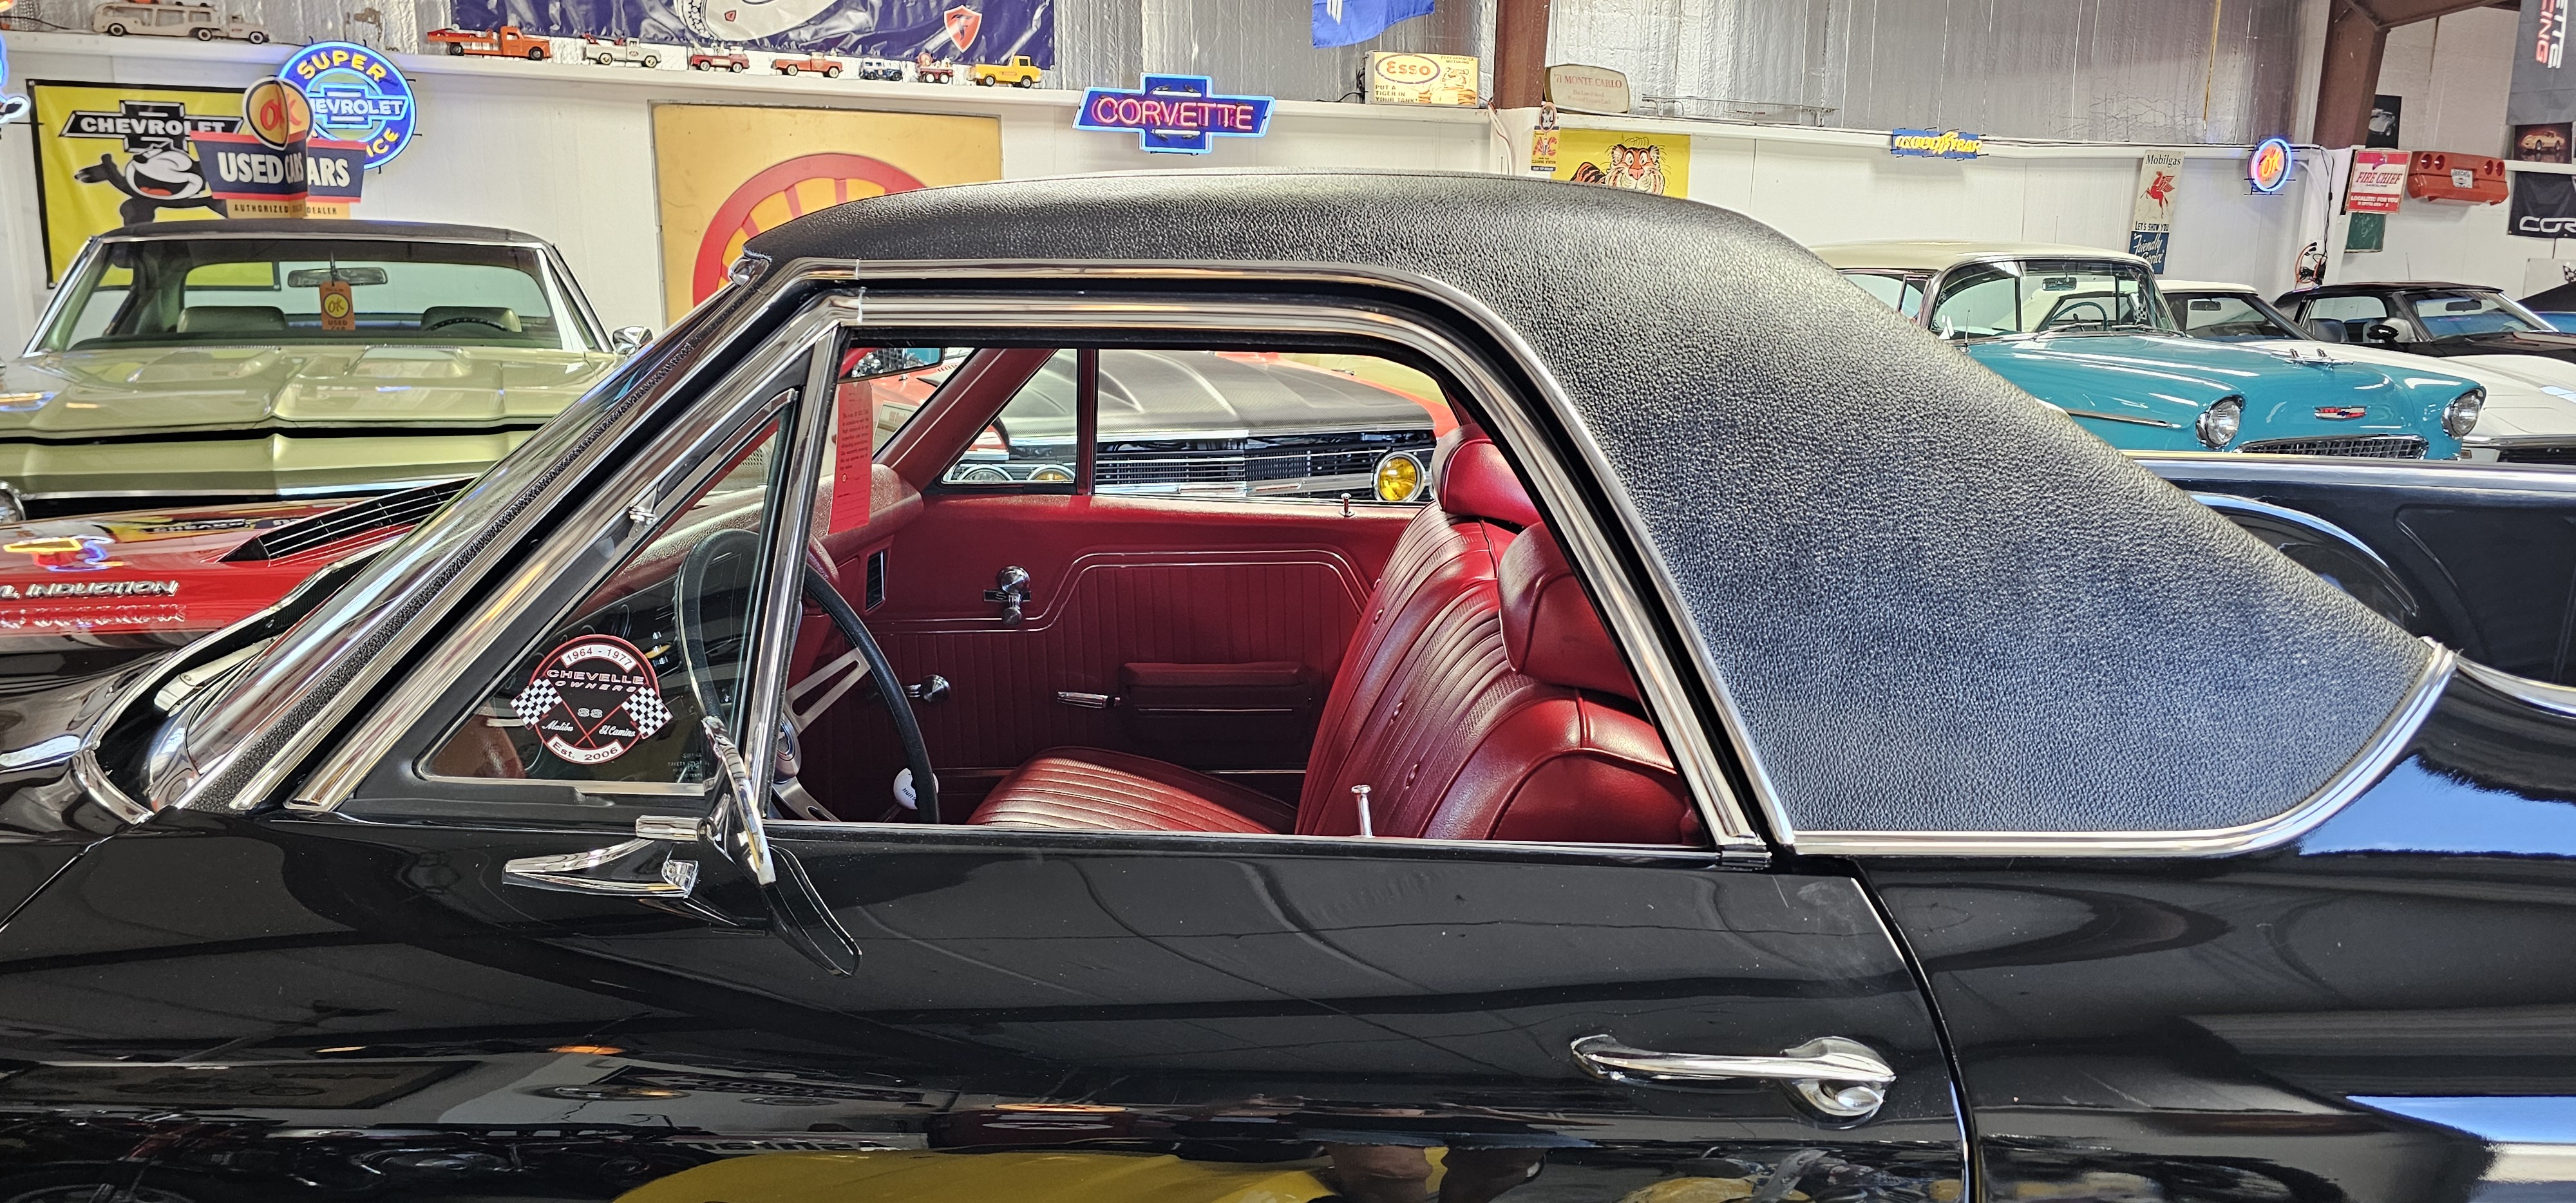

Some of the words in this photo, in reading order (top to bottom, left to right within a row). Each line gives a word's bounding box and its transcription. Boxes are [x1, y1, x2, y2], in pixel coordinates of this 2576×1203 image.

[297, 50, 387, 82] SUPER
[1564, 75, 1593, 86] MONTE
[1595, 78, 1622, 88] CARLO
[310, 97, 403, 115] EVROLET
[1096, 97, 1254, 129] CORVETTE
[217, 152, 284, 184] USED
[2146, 155, 2181, 167] Mobilgas
[307, 156, 350, 187] ARS
[2356, 172, 2375, 184] FIRE
[2376, 173, 2403, 184] CHIEF
[234, 204, 289, 213] AUTHORIZED
[26, 580, 179, 598] INDUCTION
[567, 647, 592, 663] 1964
[607, 649, 632, 667] 1977
[547, 669, 645, 685] CHEVELLE
[555, 680, 637, 692] OWNERS
[577, 708, 603, 718] SS
[542, 720, 574, 732] Malibu
[599, 725, 609, 735] El
[608, 726, 636, 737] Camino
[552, 741, 574, 759] Est.
[584, 747, 618, 761] 2006
[902, 788, 916, 801] HURS
